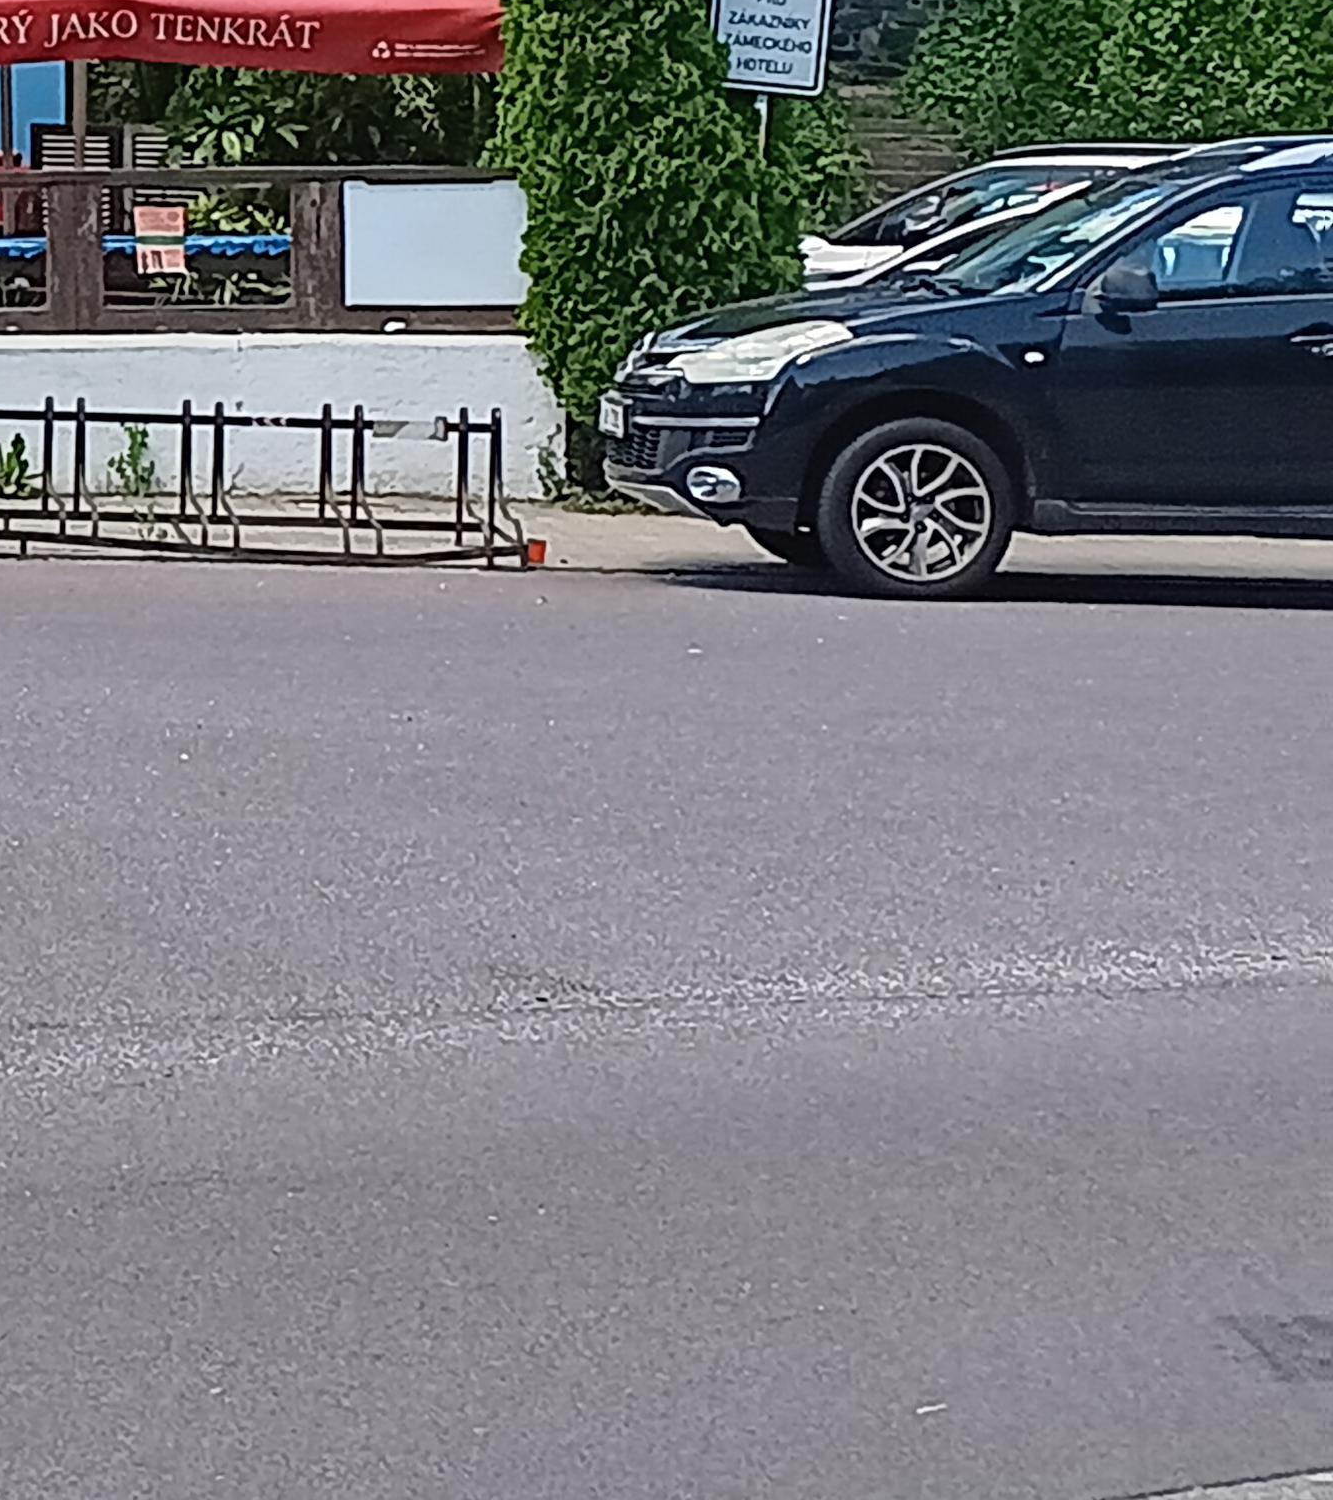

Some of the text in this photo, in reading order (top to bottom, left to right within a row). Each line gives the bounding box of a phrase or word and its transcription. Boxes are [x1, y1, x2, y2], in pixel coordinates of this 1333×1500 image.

[44, 9, 138, 48] JAKO
[150, 12, 321, 49] TENKRÁT
[736, 56, 794, 75] HOTELU
